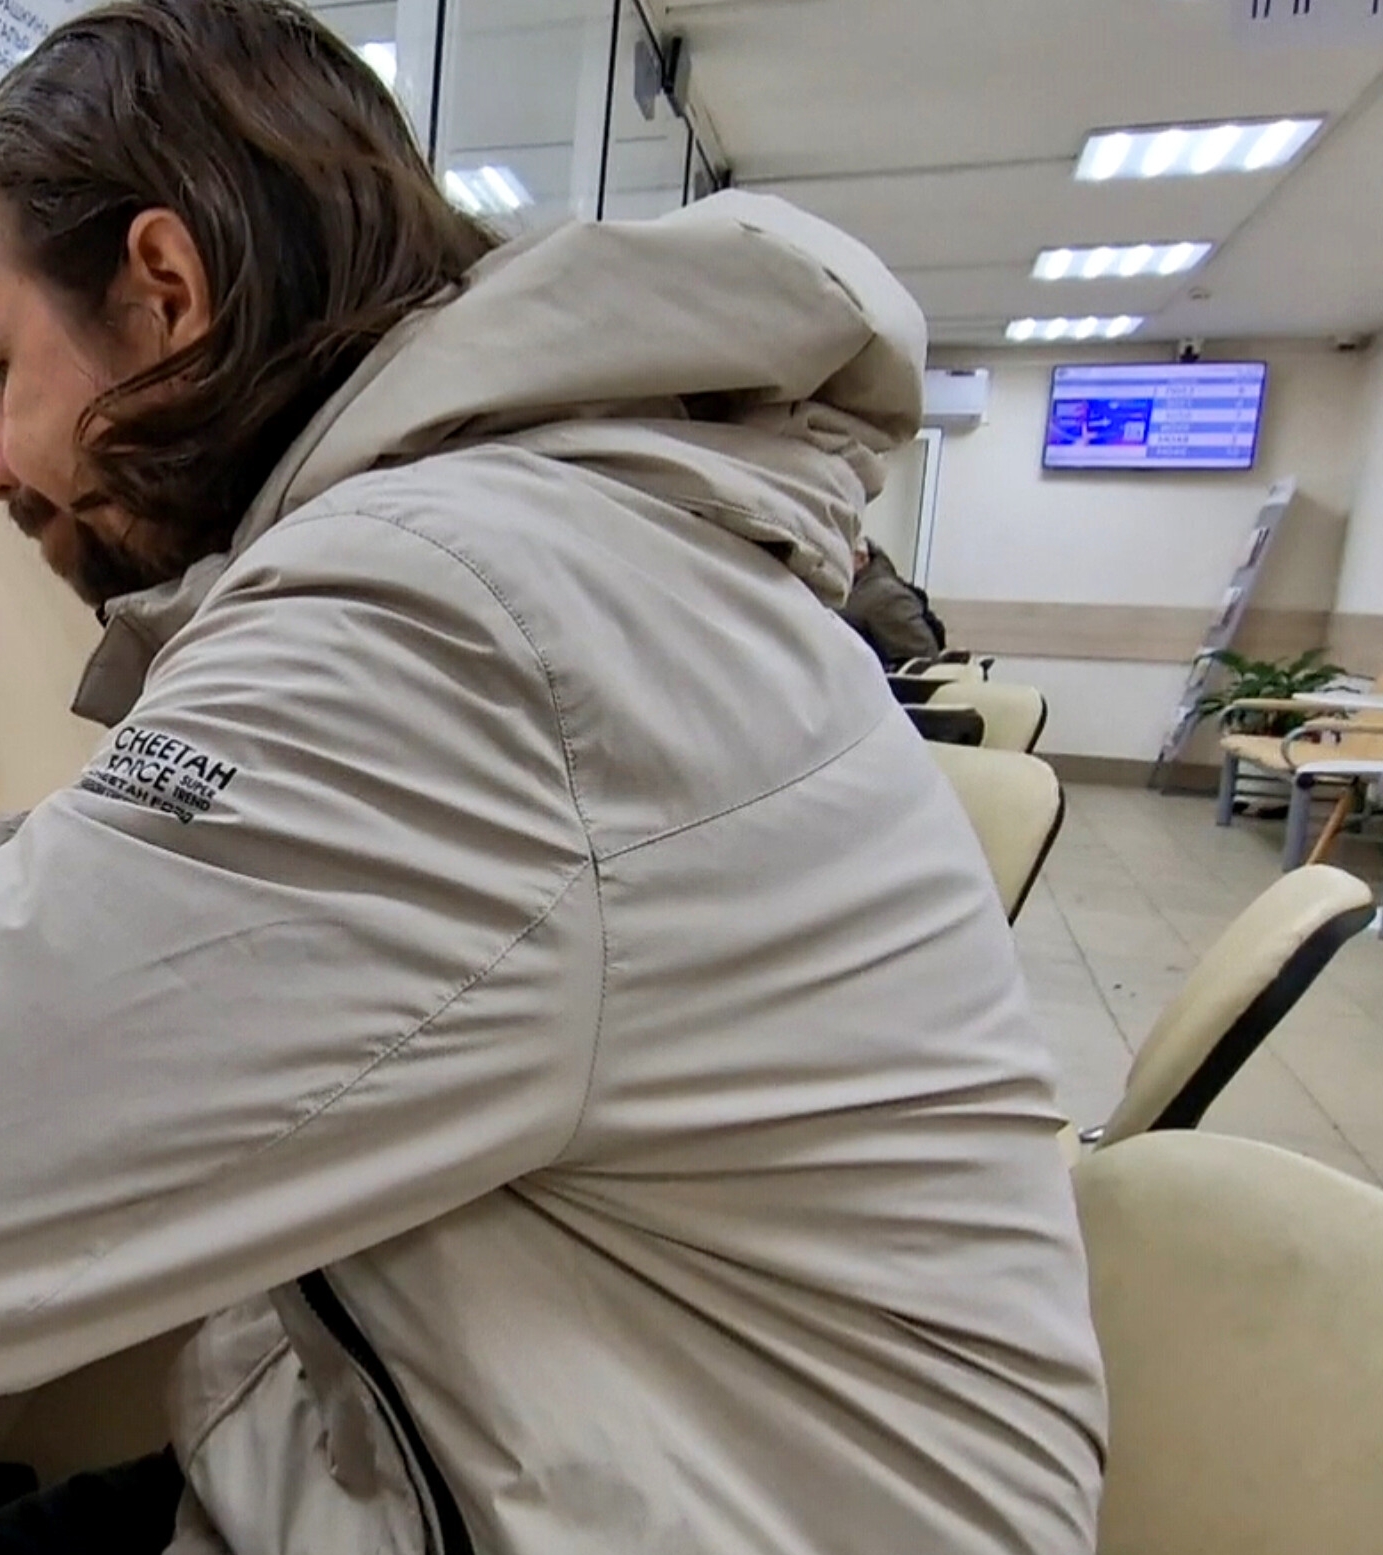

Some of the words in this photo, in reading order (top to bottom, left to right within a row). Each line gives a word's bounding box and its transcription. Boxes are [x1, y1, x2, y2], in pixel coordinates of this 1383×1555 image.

[115, 726, 237, 790] CHEETAH
[172, 785, 211, 812] TREND
[179, 774, 216, 799] SUPER
